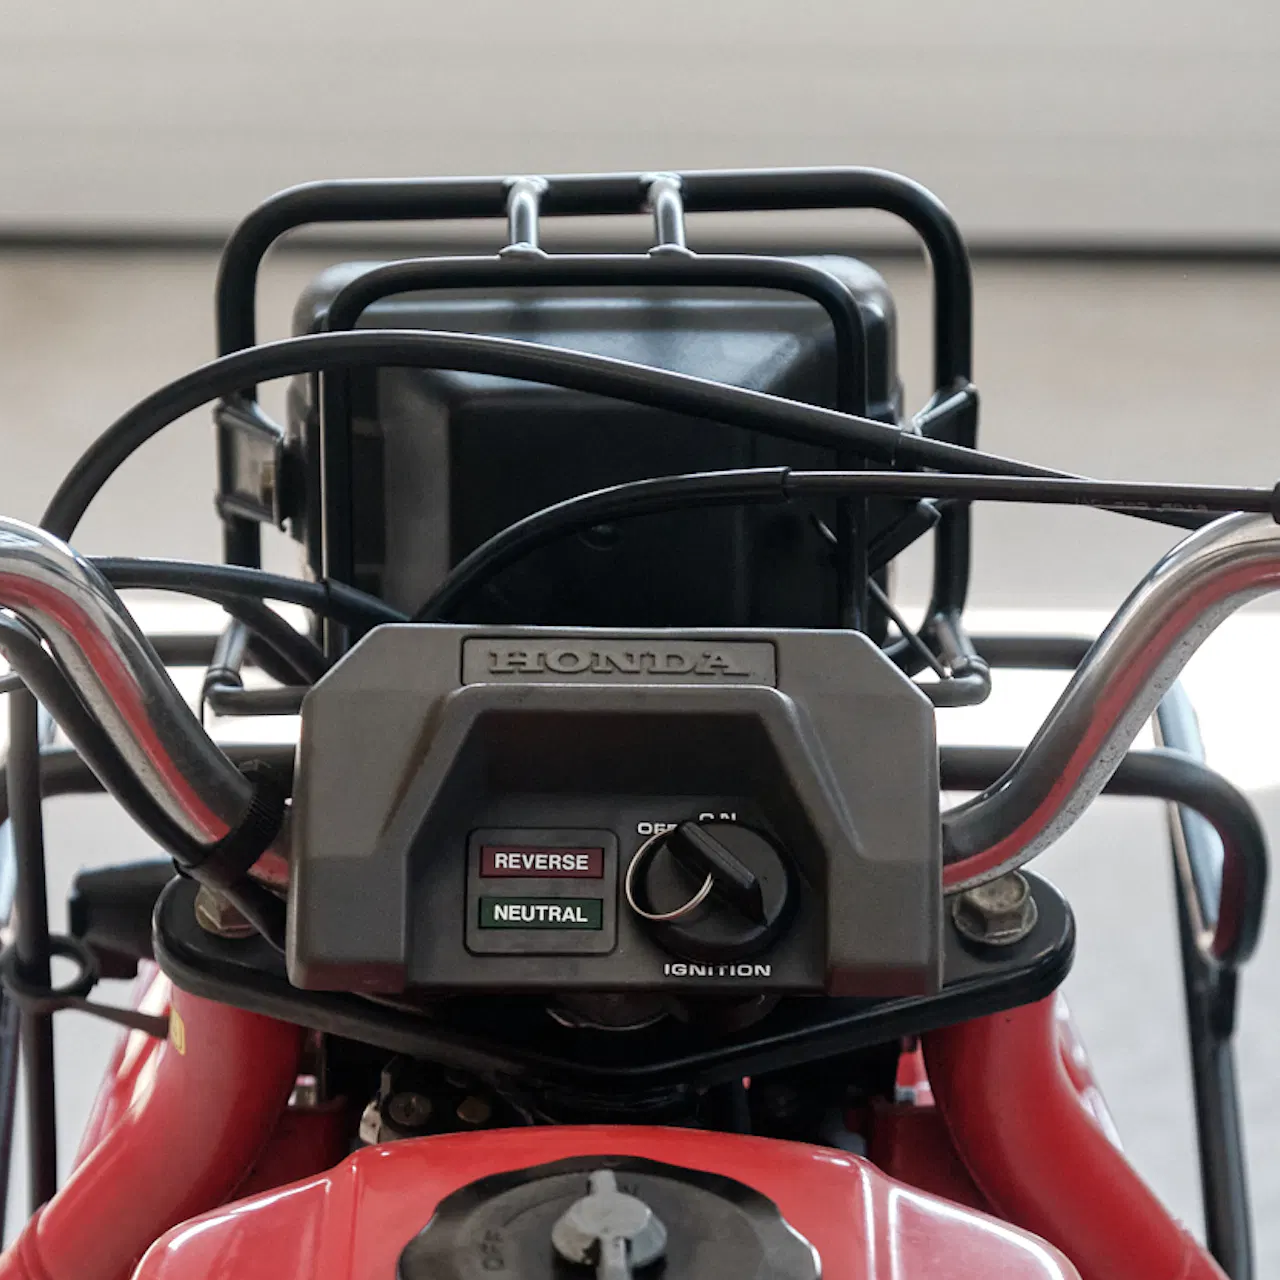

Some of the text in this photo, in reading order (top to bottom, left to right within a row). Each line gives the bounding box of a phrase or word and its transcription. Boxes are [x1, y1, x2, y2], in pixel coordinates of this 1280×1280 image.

[488, 650, 751, 677] HONDA
[494, 853, 589, 870] REVERSE
[493, 904, 588, 922] NEUTRAL
[664, 964, 771, 977] IGNITION
